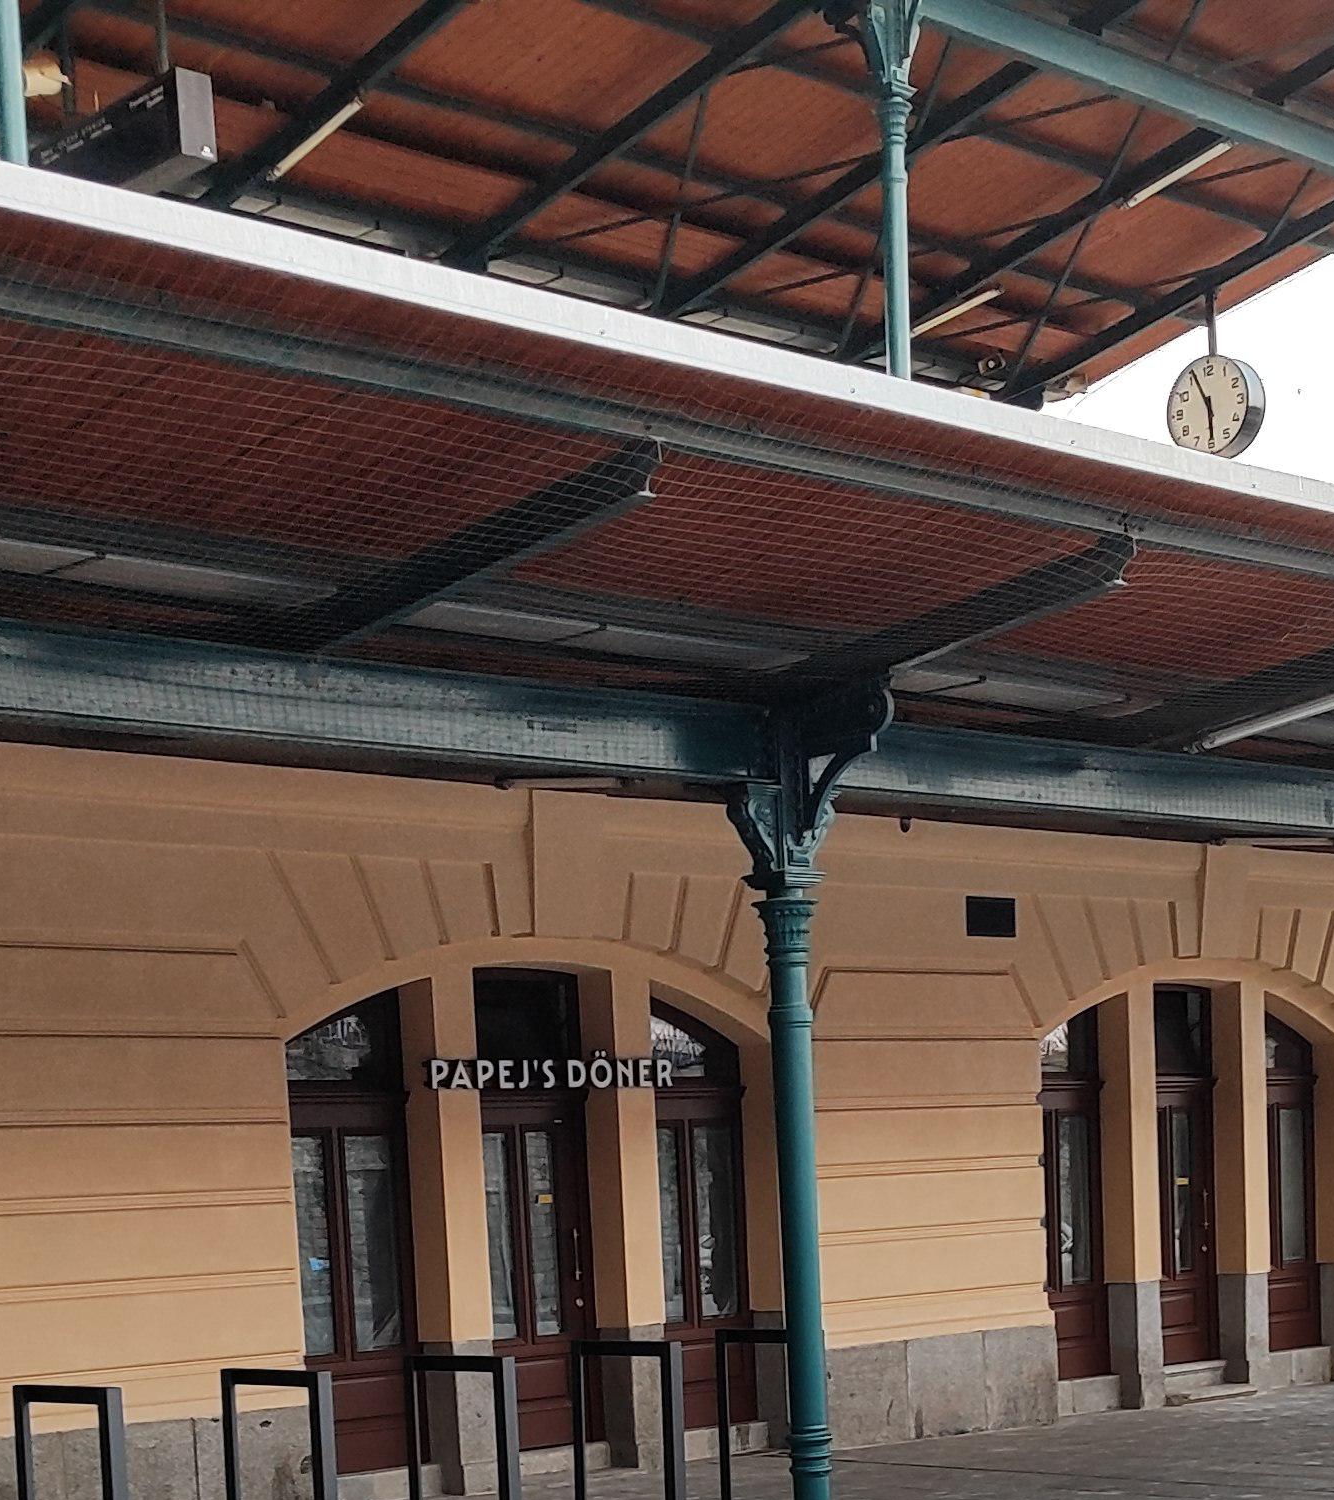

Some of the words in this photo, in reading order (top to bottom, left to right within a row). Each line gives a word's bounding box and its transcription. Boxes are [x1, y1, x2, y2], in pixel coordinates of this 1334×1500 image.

[1203, 364, 1214, 377] 12
[1231, 377, 1239, 388] 2
[1179, 390, 1189, 403] 10
[1236, 393, 1244, 404] 3
[1176, 409, 1183, 420] 9
[1232, 412, 1240, 422] 4
[1182, 425, 1189, 437] 8
[1223, 428, 1231, 439] 5
[1194, 436, 1200, 446] 7
[430, 1059, 555, 1089] PAPEJ'S
[568, 1050, 673, 1088] DÖNER
